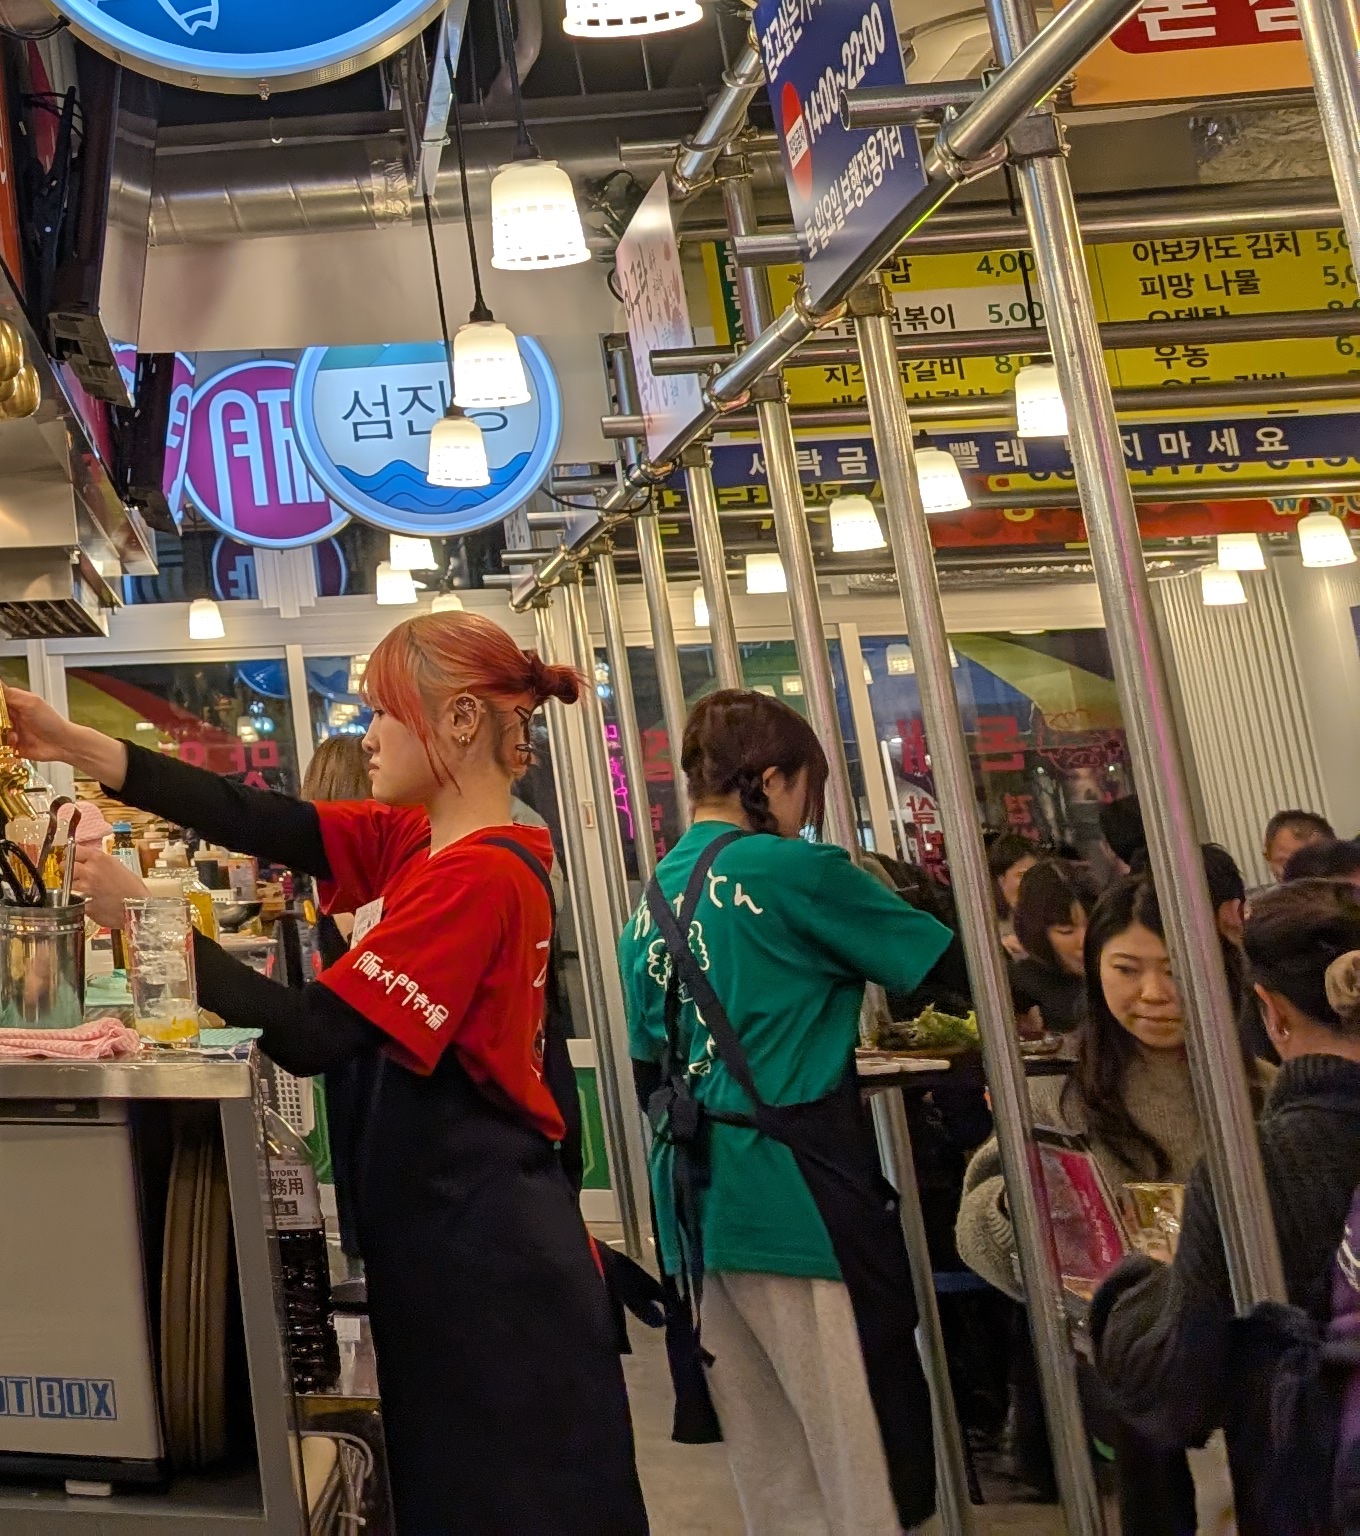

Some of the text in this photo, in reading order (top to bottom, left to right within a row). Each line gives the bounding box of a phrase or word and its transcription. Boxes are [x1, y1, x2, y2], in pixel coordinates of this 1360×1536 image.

[1132, 231, 1302, 266] 아보카도 김치
[976, 251, 1037, 277] 4,00
[1138, 268, 1261, 301] 피망 나물
[271, 1169, 299, 1177] TORY
[271, 1177, 304, 1196] 務用
[37, 1377, 116, 1421] BOX
